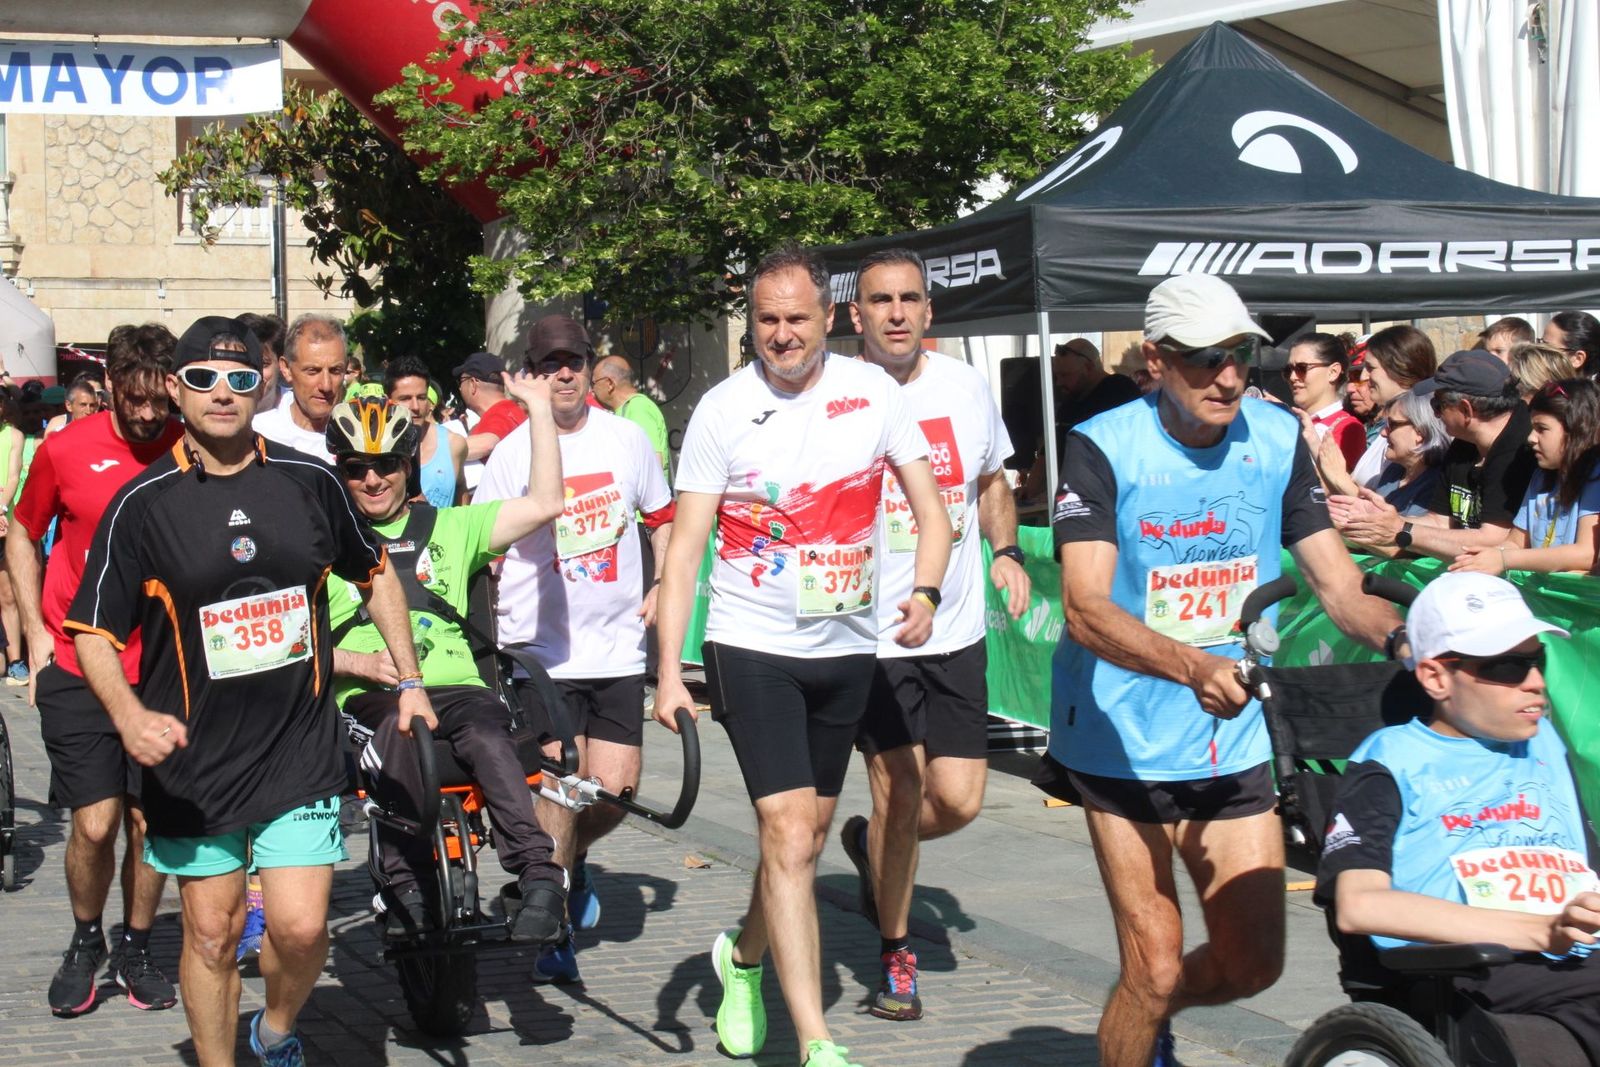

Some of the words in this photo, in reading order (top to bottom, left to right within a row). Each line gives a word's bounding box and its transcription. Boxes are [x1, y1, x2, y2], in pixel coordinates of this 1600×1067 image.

[0, 52, 233, 105] MAYOR
[925, 248, 1007, 291] RSA
[557, 490, 622, 518] edunia
[574, 510, 611, 536] 372
[1183, 544, 1247, 564] FLOWERS
[824, 567, 861, 594] 373
[1151, 562, 1256, 592] bedunia
[202, 593, 305, 629] bedunia
[1178, 590, 1228, 622] 241
[234, 618, 285, 651] 358
[1456, 850, 1588, 879] bedunia
[1504, 873, 1566, 904] 240
